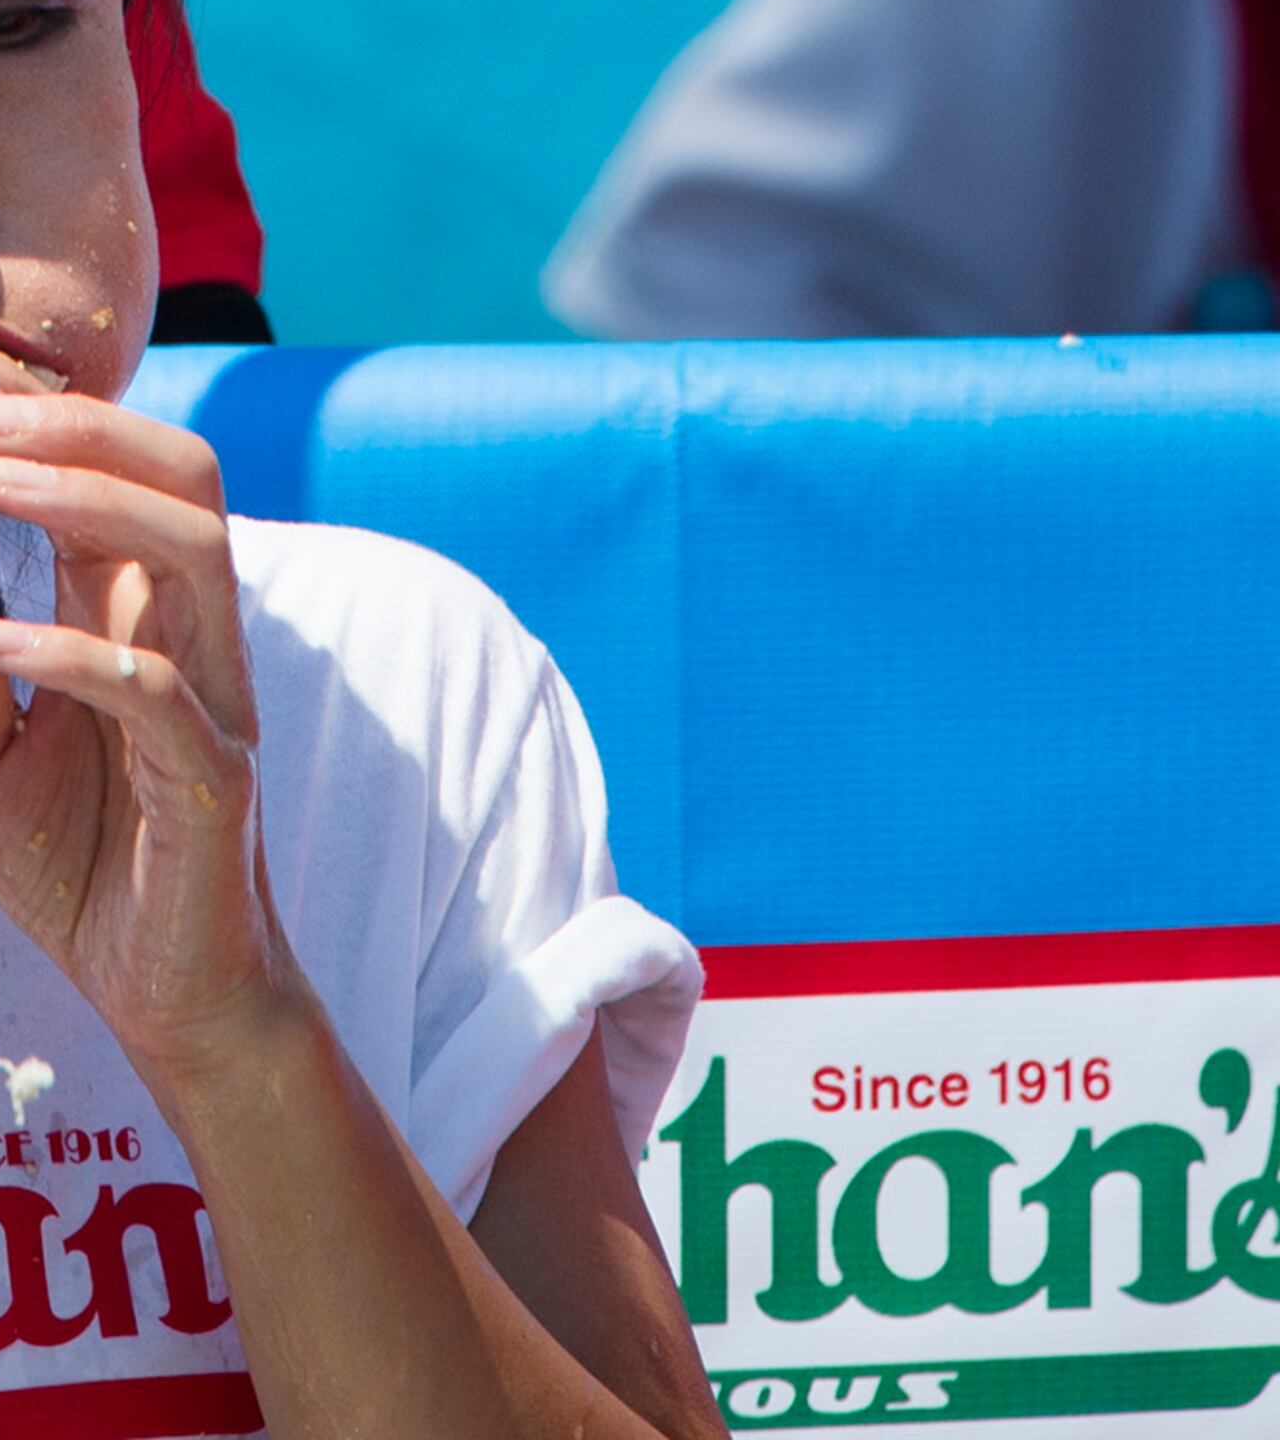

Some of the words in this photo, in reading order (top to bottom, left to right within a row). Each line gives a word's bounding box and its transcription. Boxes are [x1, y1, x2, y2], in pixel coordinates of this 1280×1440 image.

[810, 1064, 971, 1112] Since
[989, 1056, 1113, 1106] 1916
[43, 1124, 143, 1166] 1916
